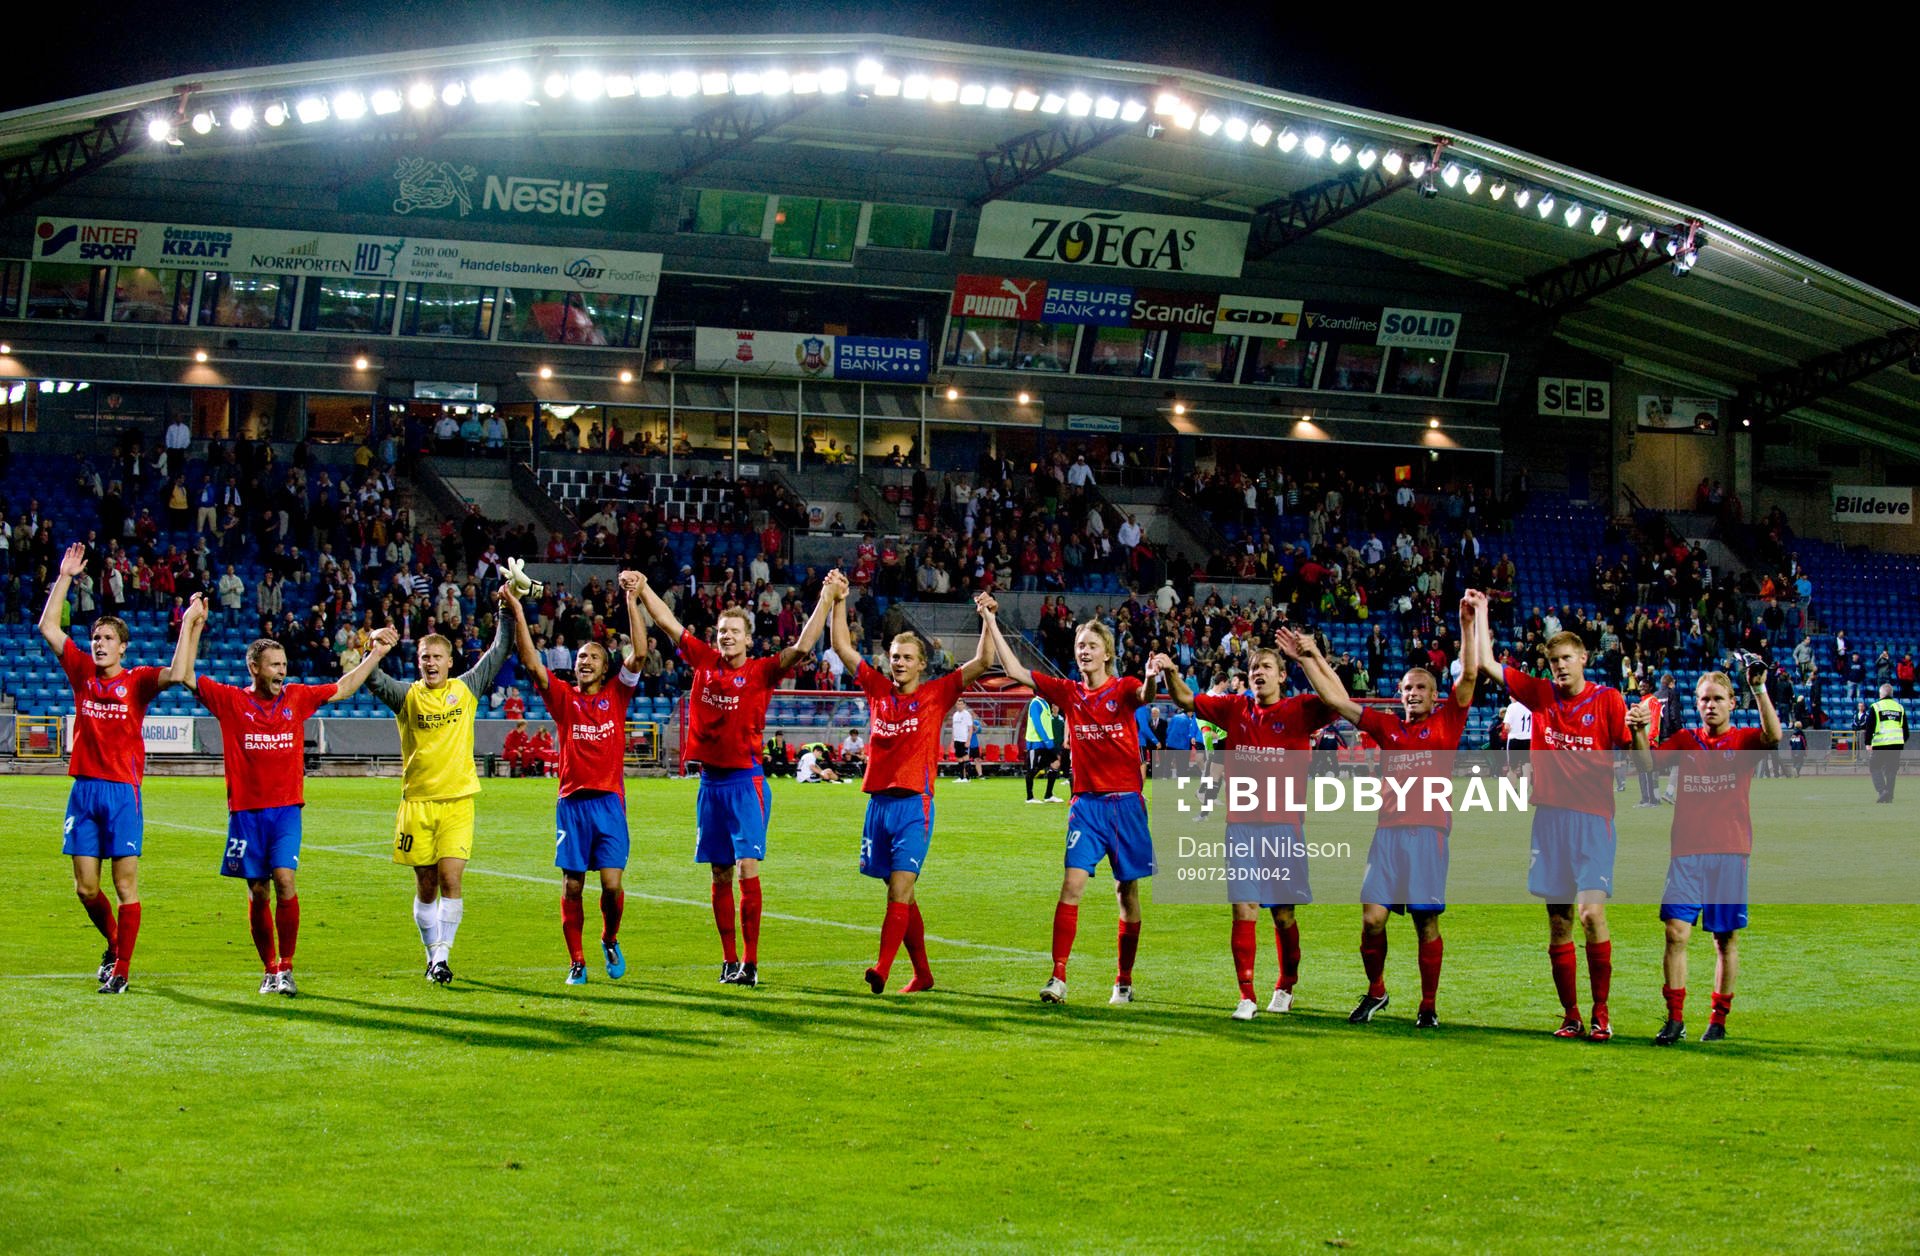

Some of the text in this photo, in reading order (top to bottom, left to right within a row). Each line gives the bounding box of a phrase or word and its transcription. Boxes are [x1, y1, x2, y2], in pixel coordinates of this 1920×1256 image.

[81, 226, 138, 244] INTER
[163, 226, 232, 243] ÖRESUNDS
[80, 243, 135, 261] SPORT
[162, 240, 231, 258] KRAFT
[354, 242, 381, 272] HD
[413, 246, 459, 258] 200 000
[250, 254, 351, 273] NORRPORTEN
[460, 258, 559, 276] Handelsbanken
[578, 268, 607, 280] JBT
[608, 269, 657, 283] FoodTech
[962, 294, 1018, 317] PUMA
[1046, 288, 1132, 306] RESURS
[1044, 303, 1093, 318] BANK
[1131, 300, 1215, 326] Scandic
[1225, 308, 1297, 327] GDL
[1318, 314, 1378, 333] Scandlines
[1384, 313, 1455, 338] SOLID
[841, 344, 922, 361] RESURS
[840, 358, 888, 372] BANK
[1543, 384, 1605, 413] SEB
[1835, 496, 1910, 515] Bildeve
[703, 687, 740, 704] RSURS
[417, 708, 463, 722] RESURS
[1521, 713, 1532, 733] 11
[572, 720, 615, 733] RESURS
[244, 732, 294, 742] RESURS
[572, 732, 601, 742] BANK
[1076, 732, 1104, 741] BANK
[1545, 727, 1594, 745] RESURS
[244, 741, 278, 750] BANK
[1235, 744, 1285, 756] RESURS
[1235, 753, 1262, 763] BANK
[1388, 750, 1433, 763] RESURS
[1387, 762, 1412, 772] BANK
[1683, 773, 1736, 785] RESURS
[1683, 784, 1716, 793] BANK
[226, 837, 248, 859] 23
[398, 832, 413, 853] 30
